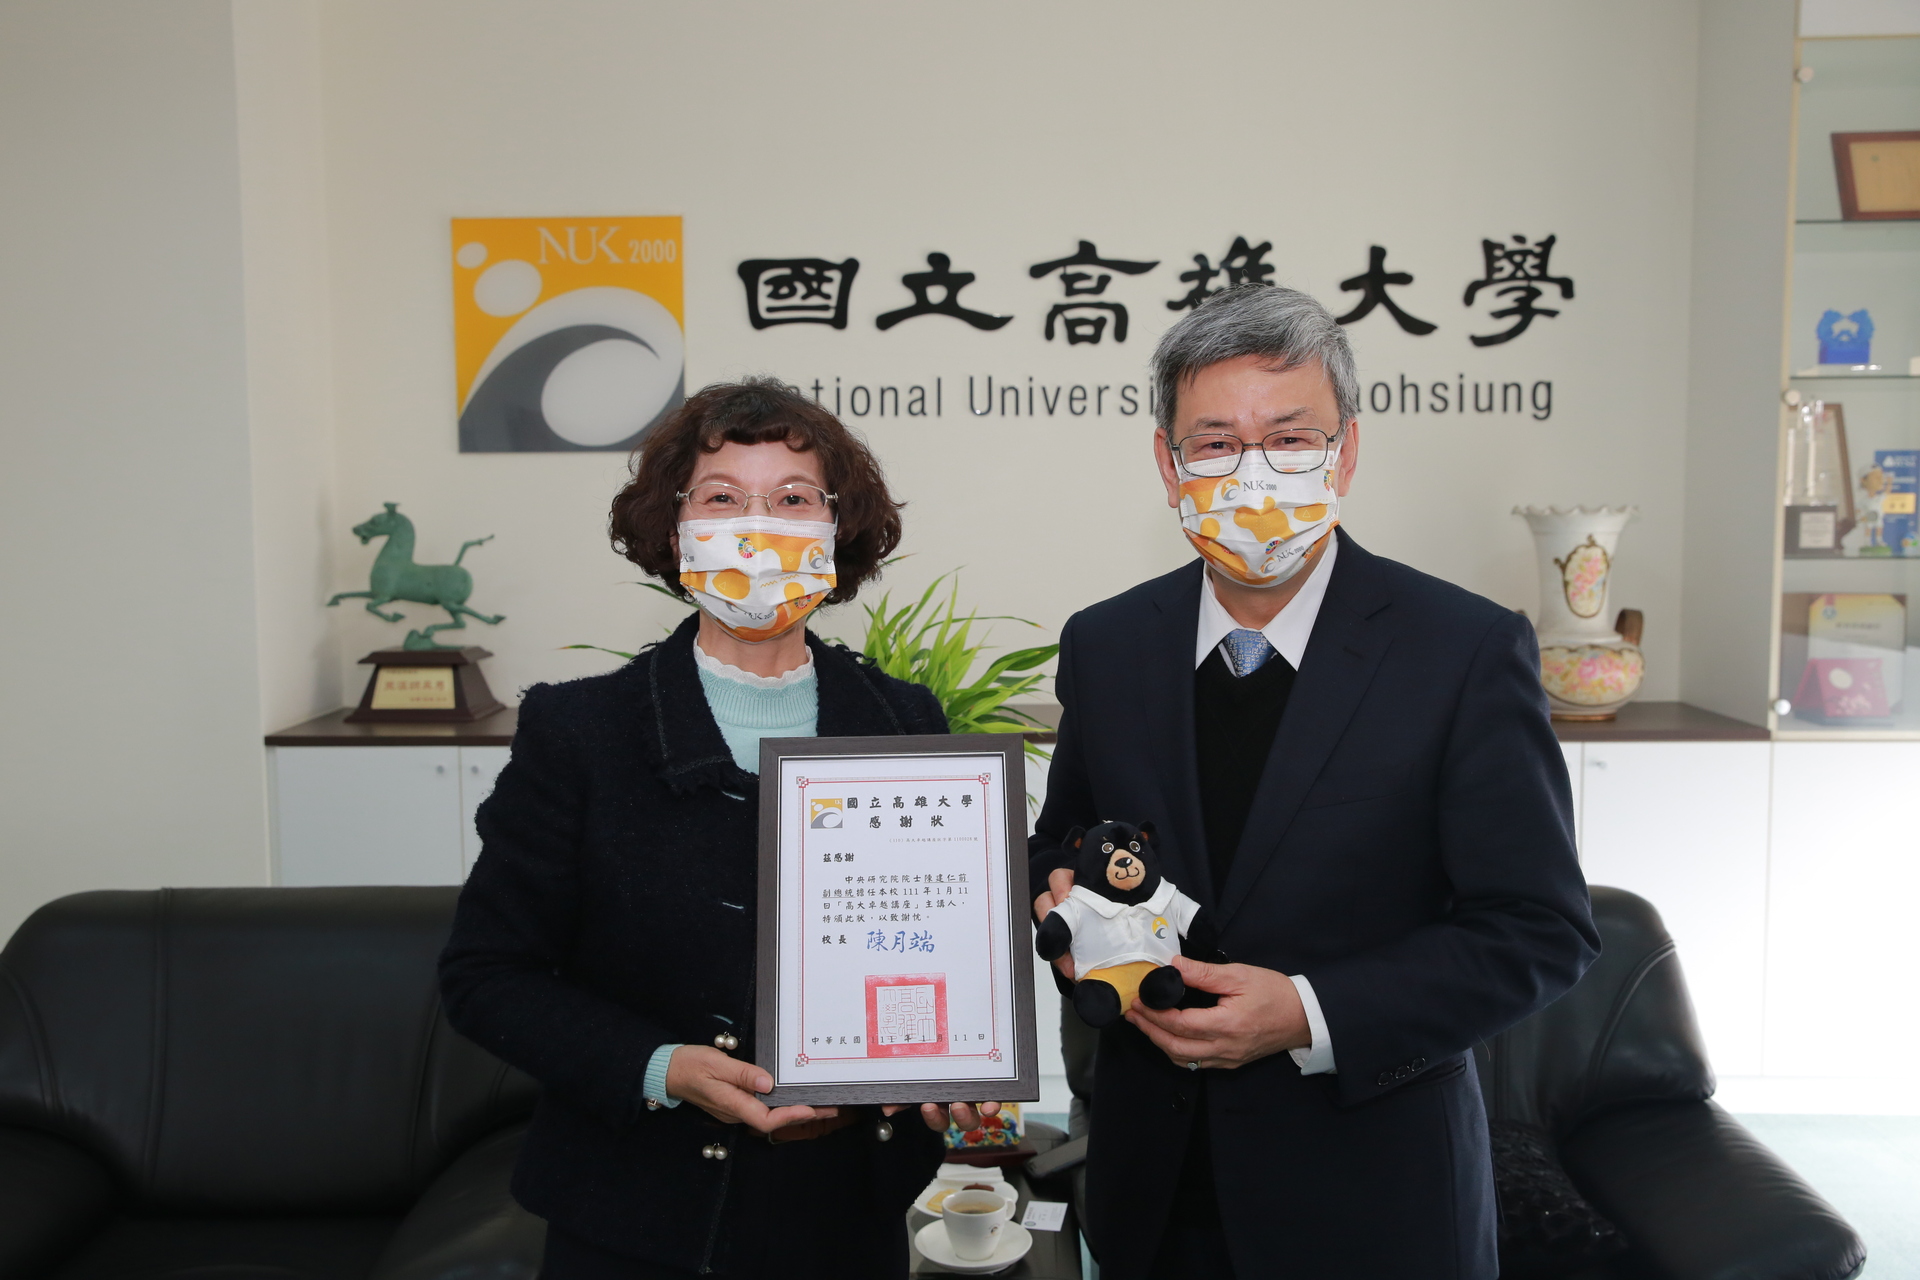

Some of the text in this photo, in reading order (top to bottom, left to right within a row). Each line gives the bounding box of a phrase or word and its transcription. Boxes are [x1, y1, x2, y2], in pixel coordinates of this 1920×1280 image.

[536, 225, 678, 264] NUK 2000
[968, 376, 1154, 418] Universi
[847, 794, 973, 809] 國立高雄大學
[869, 814, 944, 829] 感謝狀
[821, 934, 848, 945] 校長
[866, 928, 936, 954] 陳月端
